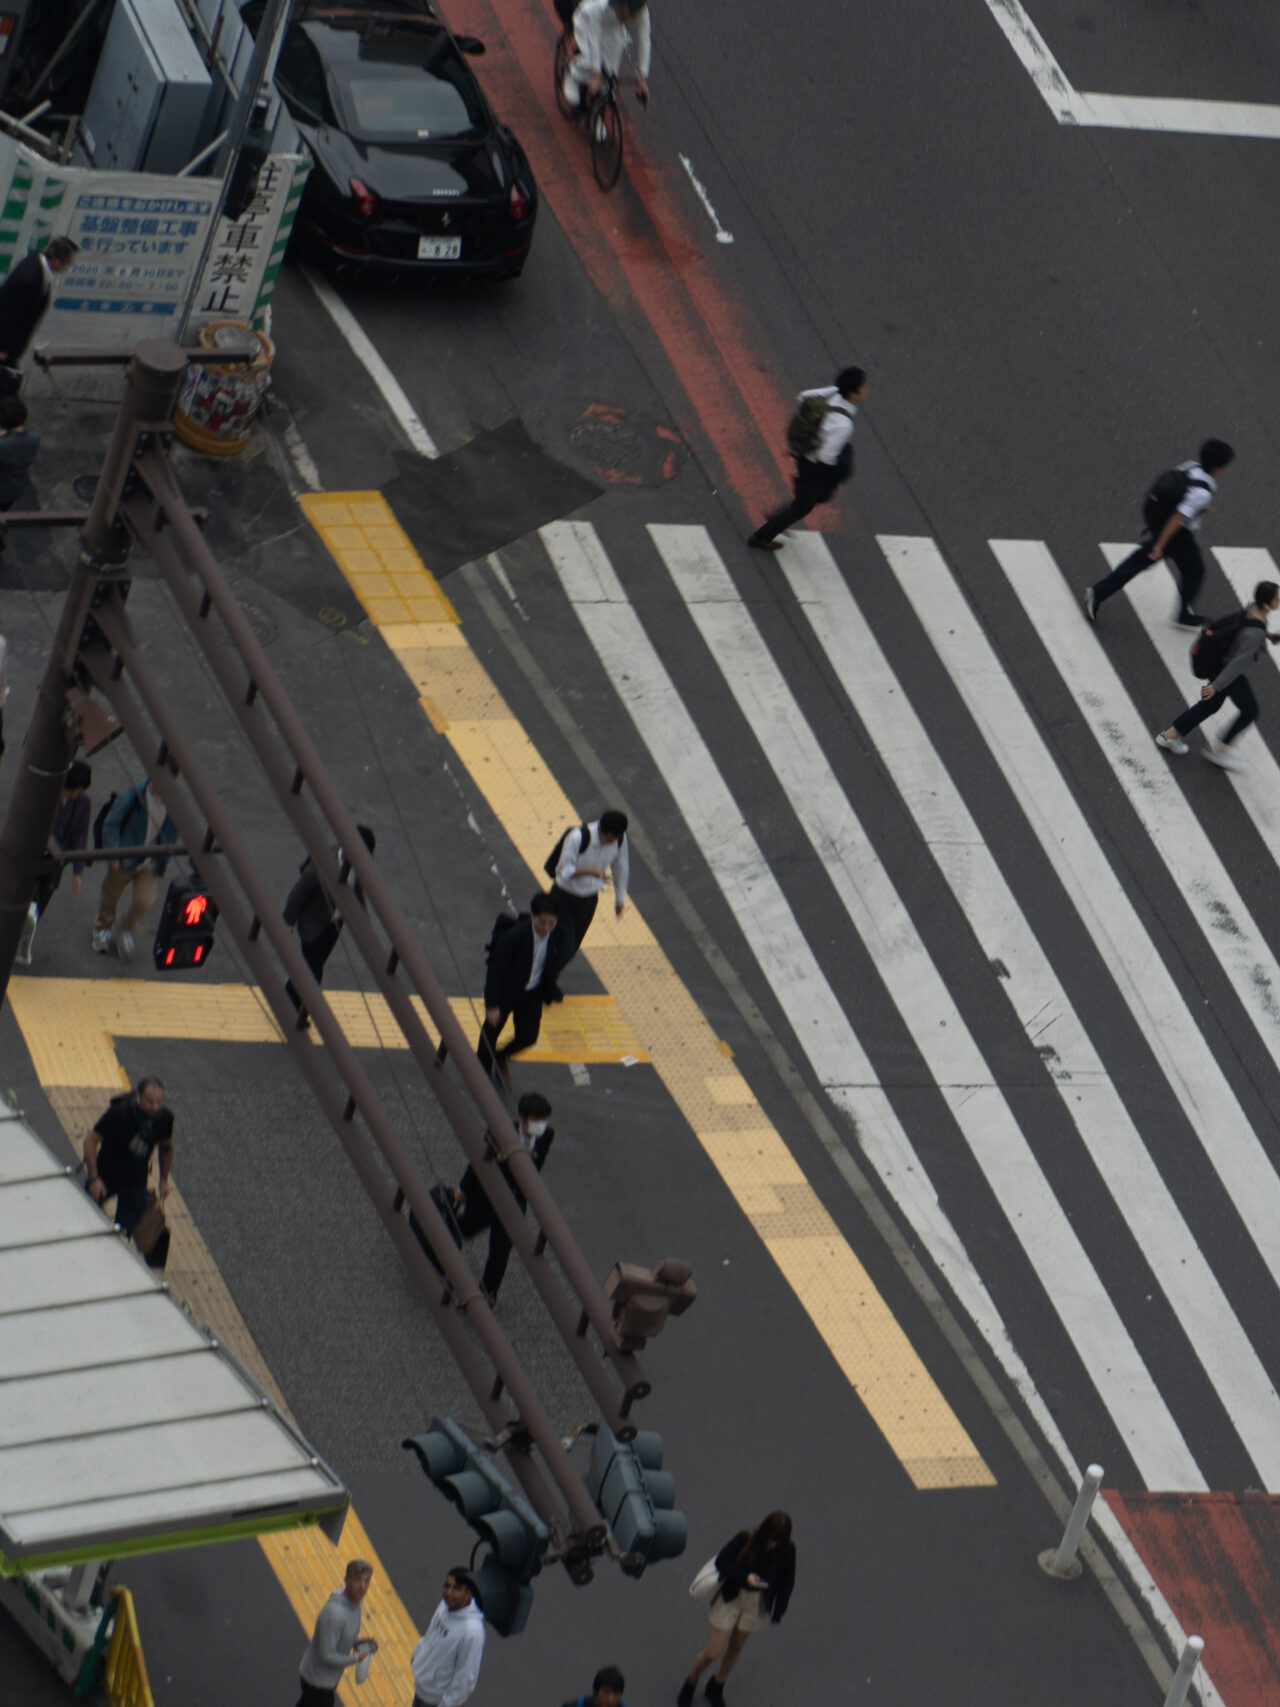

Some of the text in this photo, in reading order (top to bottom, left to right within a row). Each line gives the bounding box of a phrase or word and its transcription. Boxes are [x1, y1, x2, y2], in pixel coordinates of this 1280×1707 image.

[80, 215, 199, 237] 基盤整備工事
[81, 237, 189, 254] を行っています
